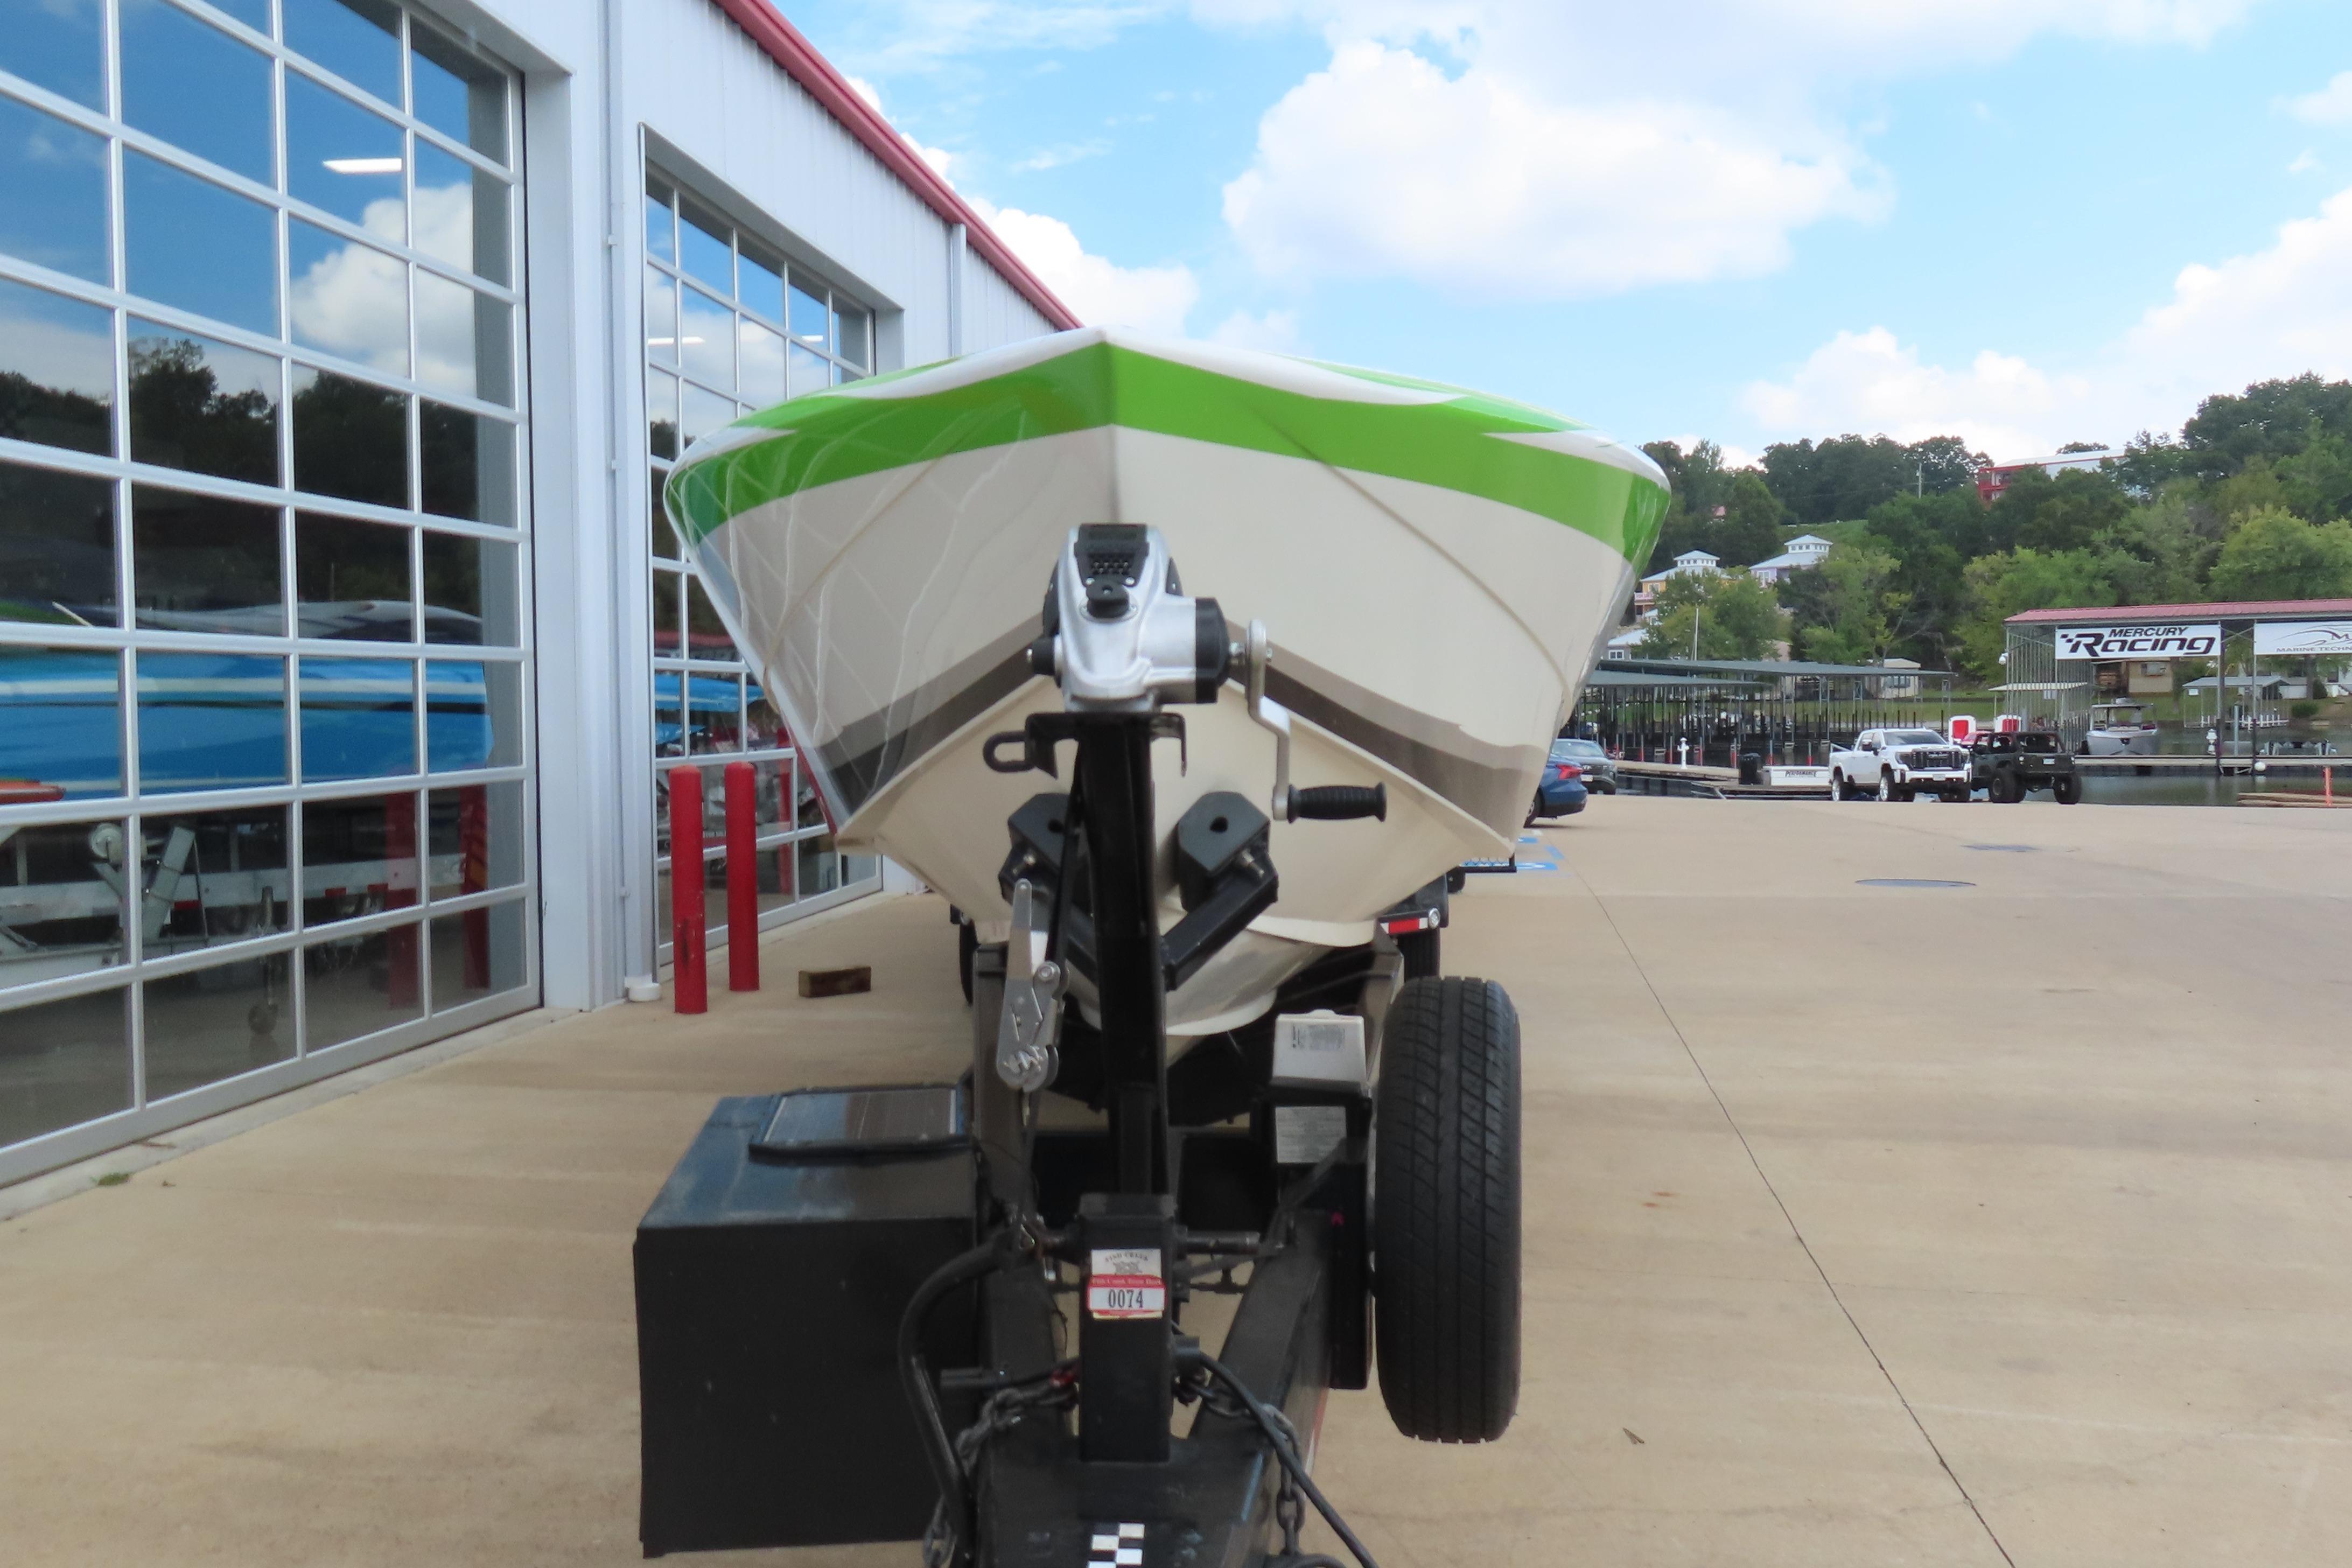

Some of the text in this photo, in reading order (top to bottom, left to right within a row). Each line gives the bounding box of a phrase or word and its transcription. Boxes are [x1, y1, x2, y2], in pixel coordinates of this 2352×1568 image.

[2108, 627, 2189, 638] MERCURY
[2068, 633, 2216, 657] Racing
[1109, 1289, 1143, 1308] 0074
